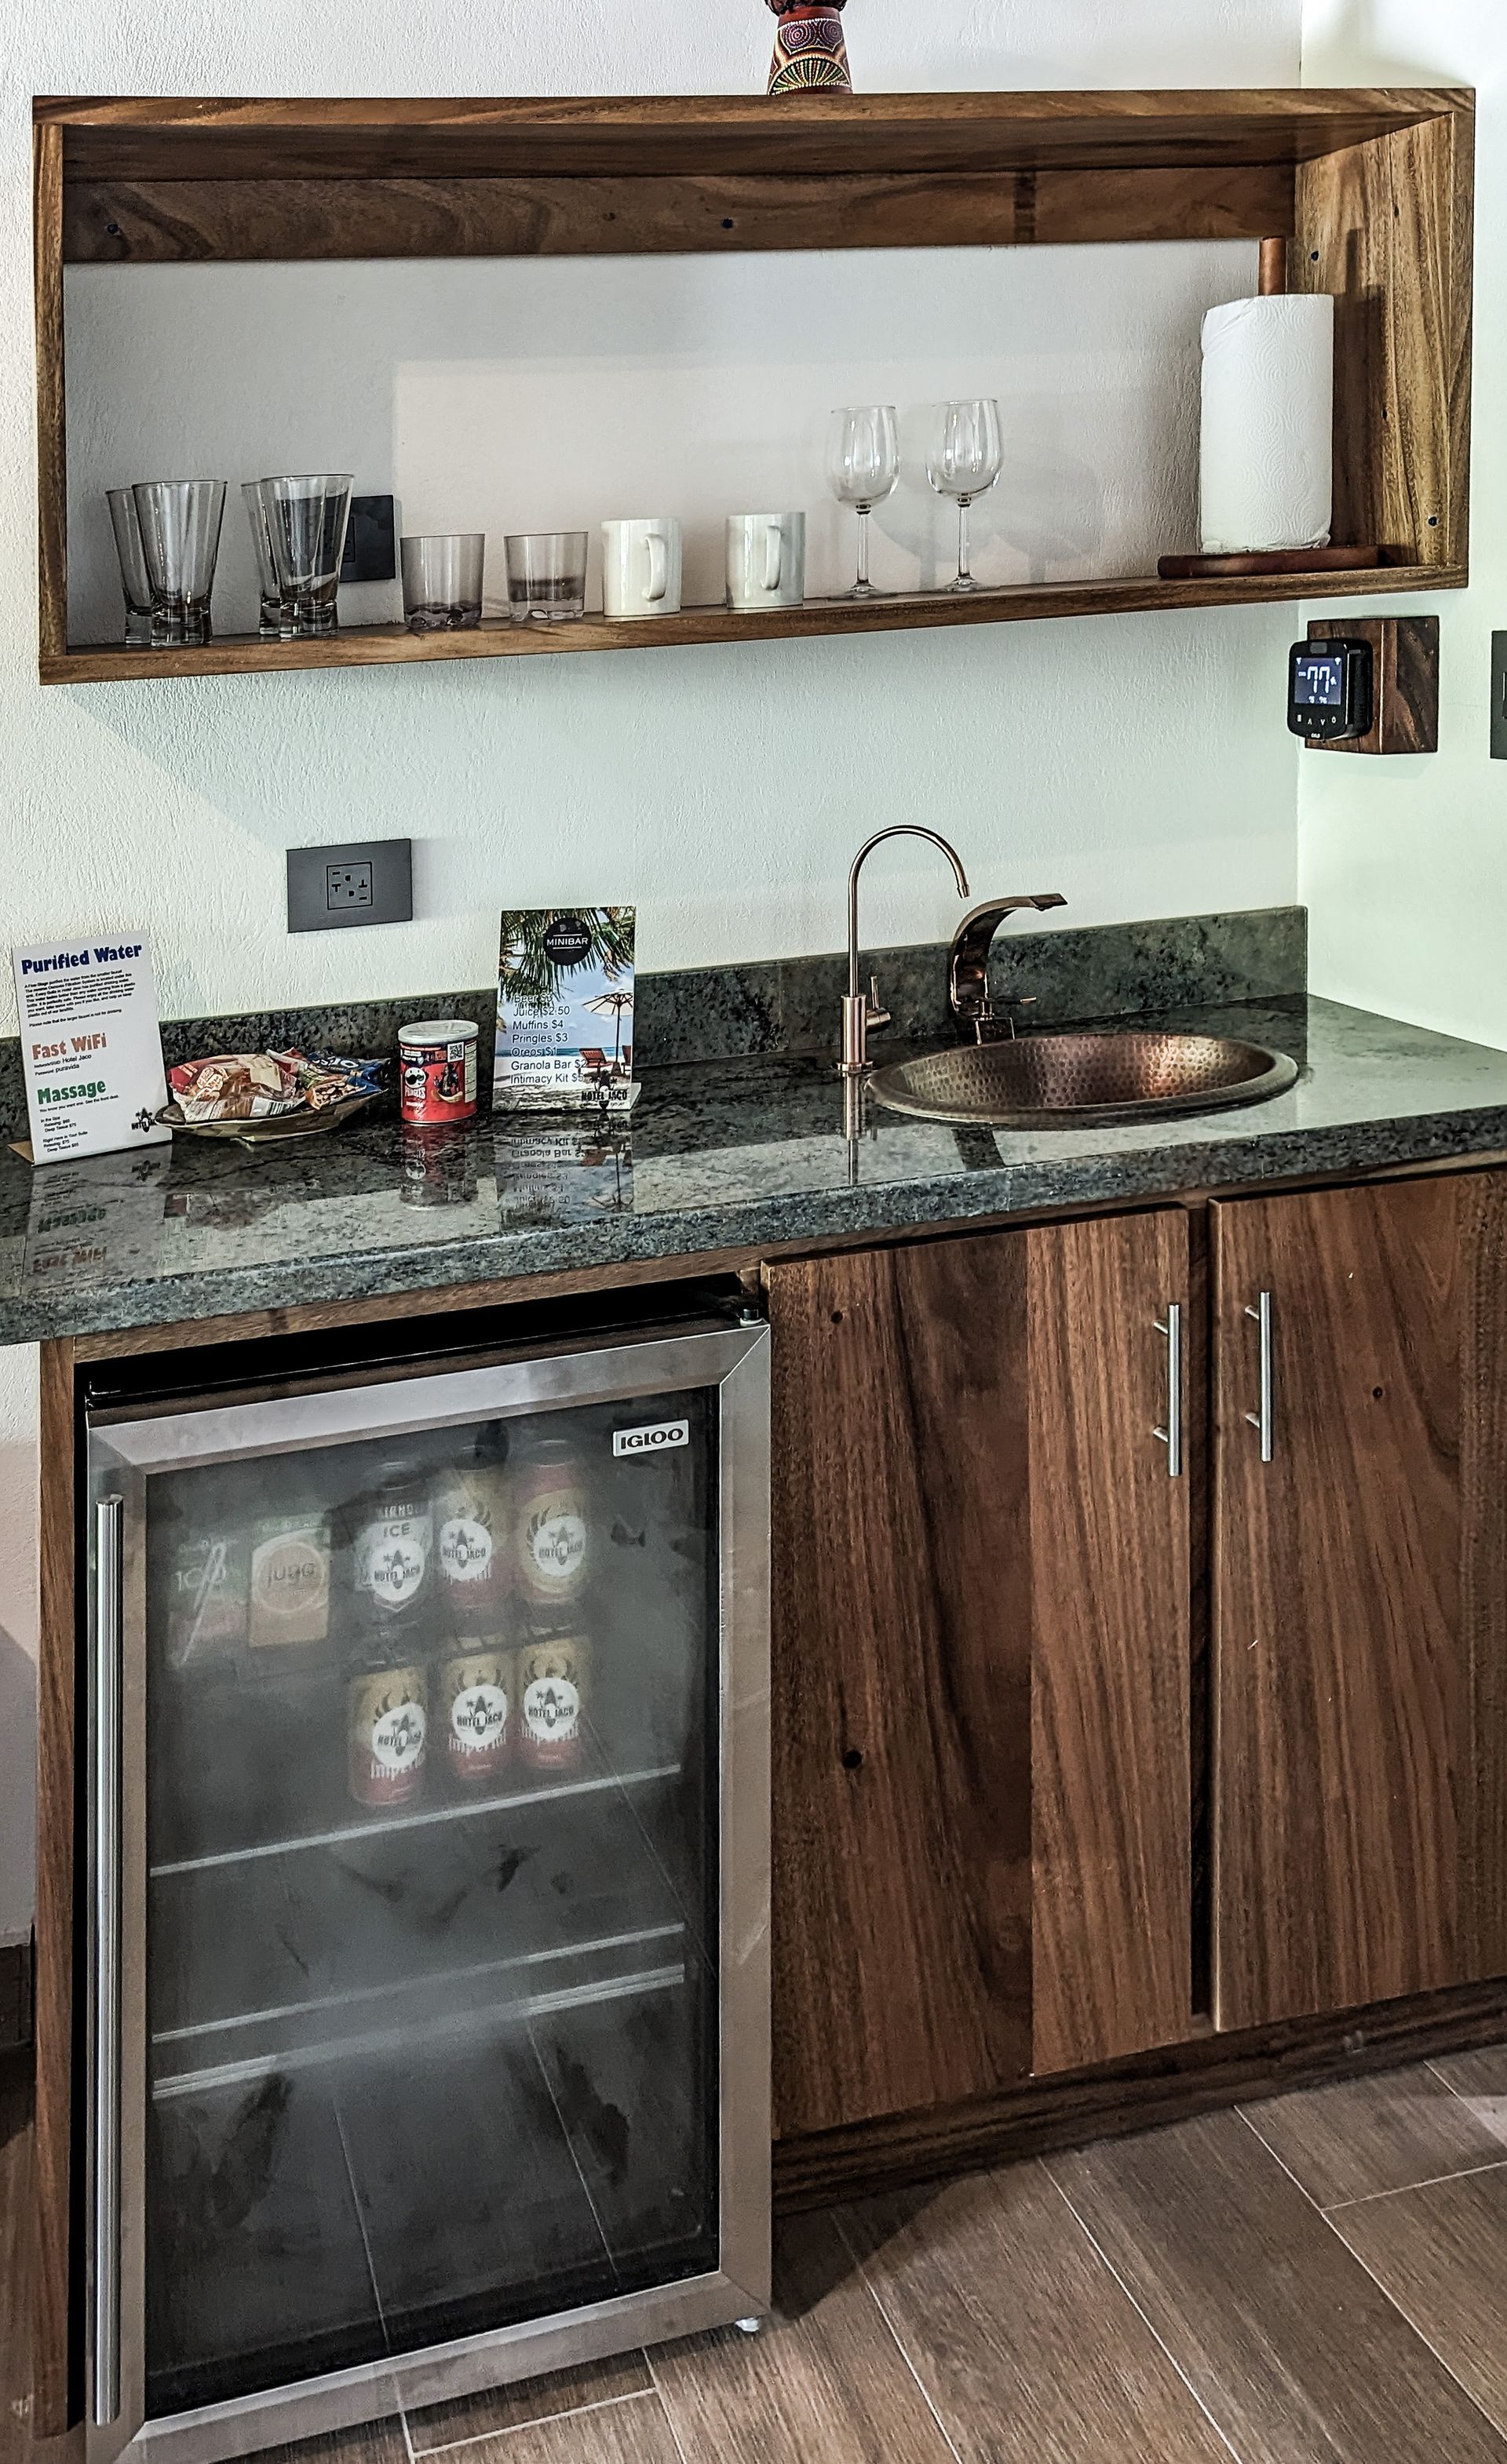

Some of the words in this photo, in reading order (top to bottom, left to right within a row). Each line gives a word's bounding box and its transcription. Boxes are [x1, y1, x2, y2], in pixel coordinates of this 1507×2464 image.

[547, 938, 589, 946] MINIBAR
[21, 950, 89, 975] Purified
[94, 945, 142, 963] Water
[514, 994, 538, 1004] Beer
[513, 1008, 538, 1017] Juice
[542, 1006, 571, 1015] $2.50
[513, 1020, 549, 1030] Muffins
[552, 1019, 564, 1029] $4
[512, 1034, 553, 1045] Pringles
[556, 1033, 568, 1042] $3
[32, 1041, 67, 1060] Fast
[71, 1033, 107, 1052] WiFi
[512, 1048, 542, 1056] Oreos
[56, 1063, 79, 1073] puravida
[511, 1061, 551, 1070] Granola
[554, 1060, 571, 1070] Bar
[575, 1059, 587, 1069] $2
[511, 1074, 552, 1084] Intimacy
[556, 1073, 568, 1083] Kit
[571, 1073, 584, 1082] $5
[37, 1081, 106, 1105] Massage
[581, 1091, 604, 1102] HOTEL
[621, 1428, 684, 1449] IGLOO
[384, 1522, 411, 1537] ICE
